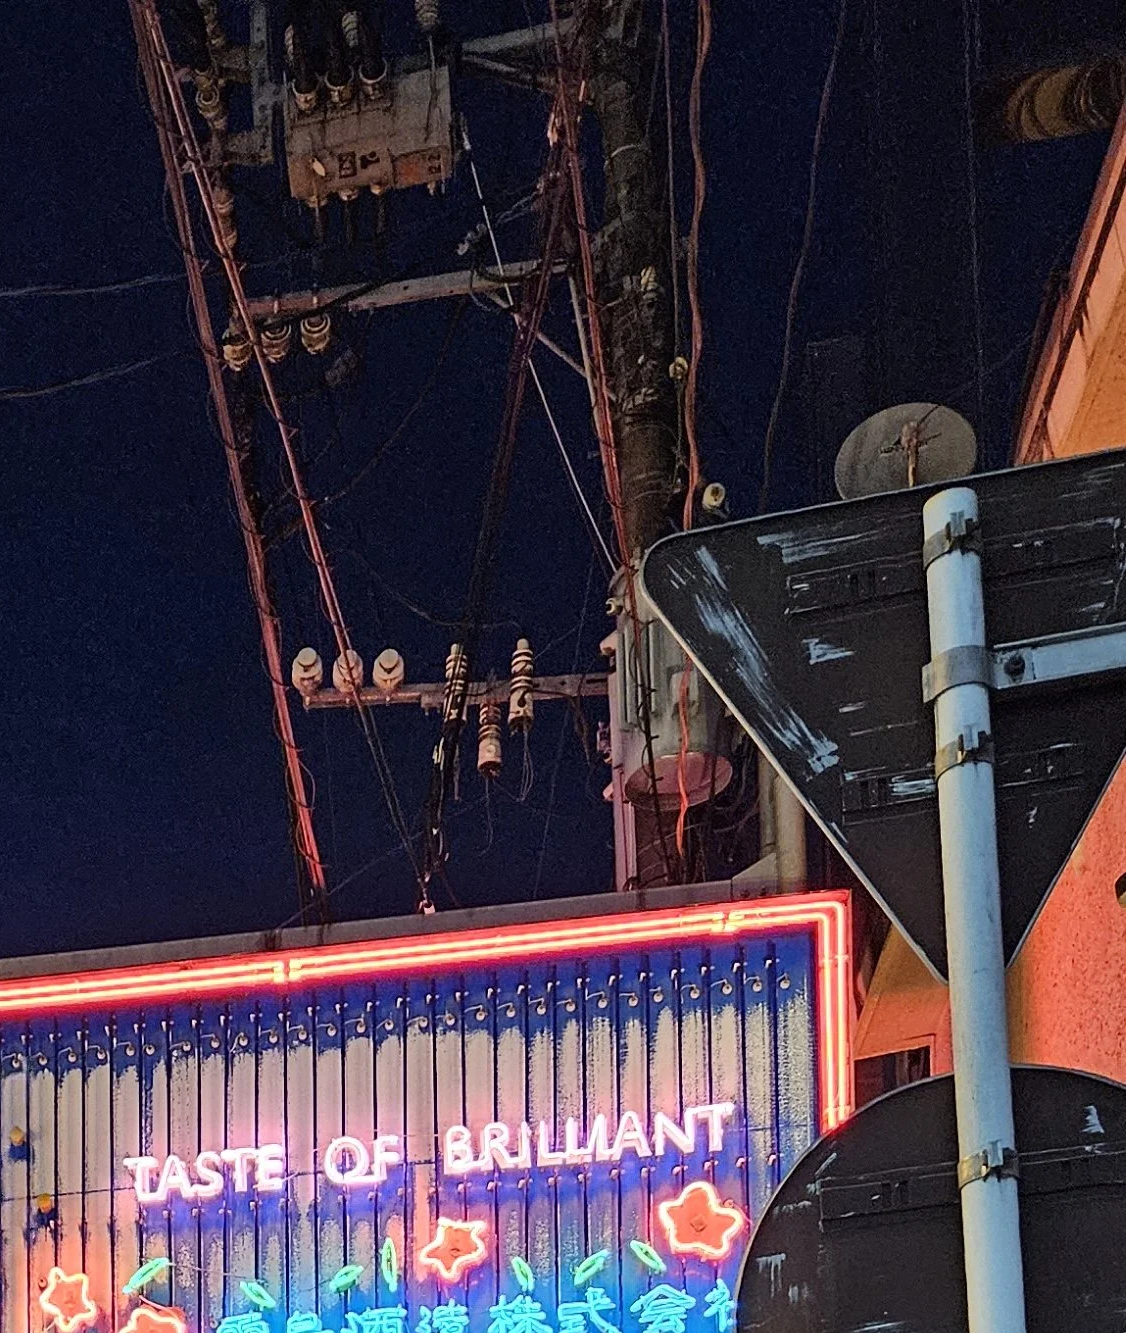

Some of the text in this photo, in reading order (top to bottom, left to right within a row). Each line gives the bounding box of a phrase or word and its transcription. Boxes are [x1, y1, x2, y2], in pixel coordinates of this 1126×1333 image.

[124, 1101, 735, 1202] TASTE OF BRILLIANT
